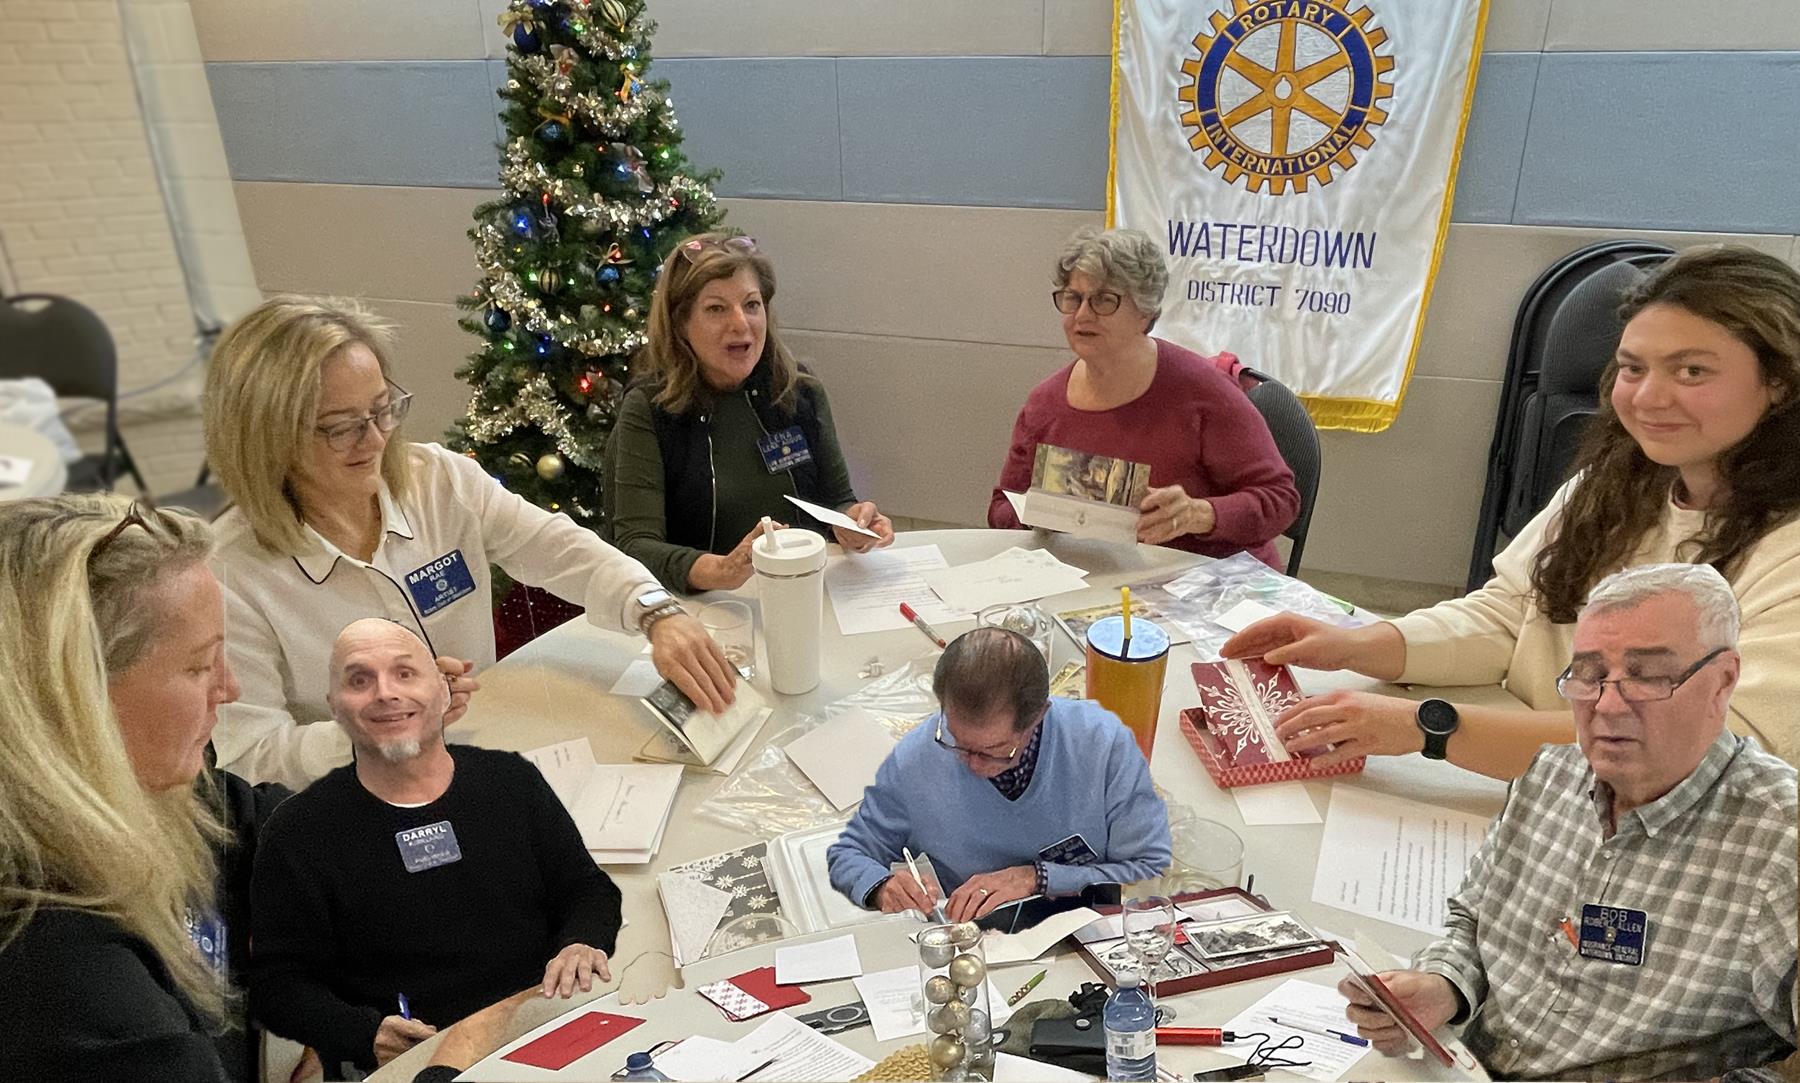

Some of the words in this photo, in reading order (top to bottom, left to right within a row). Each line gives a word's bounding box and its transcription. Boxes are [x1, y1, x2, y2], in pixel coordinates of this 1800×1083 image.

[1239, 0, 1336, 31] ROTARY
[1206, 121, 1358, 175] INTERNATIONAL
[1168, 219, 1377, 269] WATERDOWN
[1187, 279, 1282, 307] DISTRICT
[1295, 288, 1351, 315] 7090
[408, 552, 458, 585] MARGOT
[428, 570, 446, 583] RAE
[434, 586, 458, 603] ARTIST
[402, 825, 447, 842] DARRYL
[1600, 908, 1628, 922] BOB
[1618, 920, 1643, 933] ALLEN
